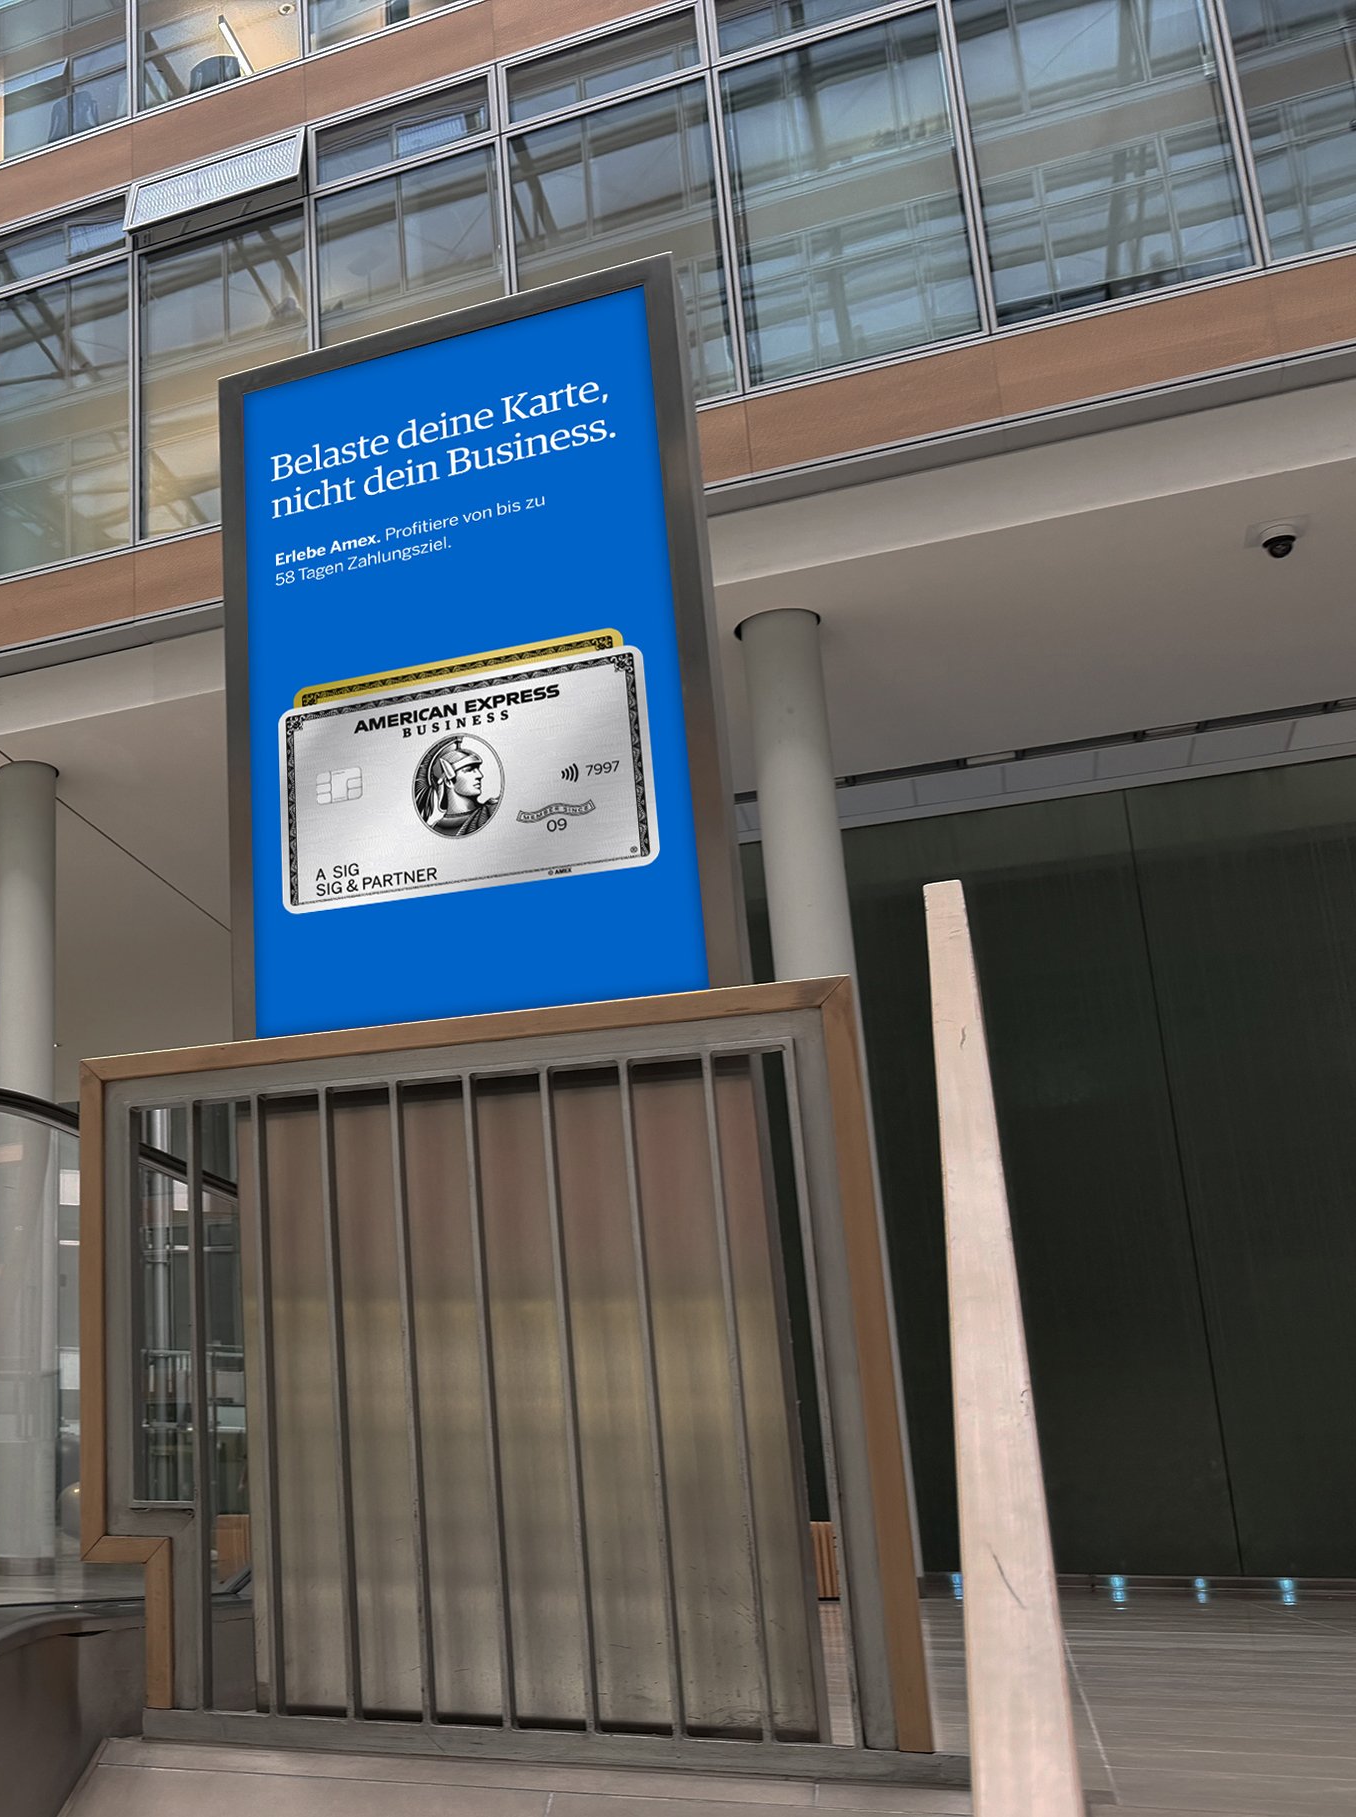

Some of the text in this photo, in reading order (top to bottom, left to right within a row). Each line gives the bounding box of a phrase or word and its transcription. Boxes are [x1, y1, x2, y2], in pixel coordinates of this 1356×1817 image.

[271, 381, 608, 482] Belaste deine Karte,
[271, 419, 616, 519] nicht dein Business.
[275, 496, 546, 567] Erlebe Amex. Profitiere von bis zu
[275, 536, 452, 586] 58 Tagen Zahlungsziel.
[353, 683, 560, 735] AMERICAN EXPRESS
[402, 709, 510, 738] BUSINESS
[585, 760, 620, 776] 7997
[546, 817, 568, 833] 09
[315, 862, 360, 882] A SIG
[315, 866, 438, 898] SIG & PARTNER
